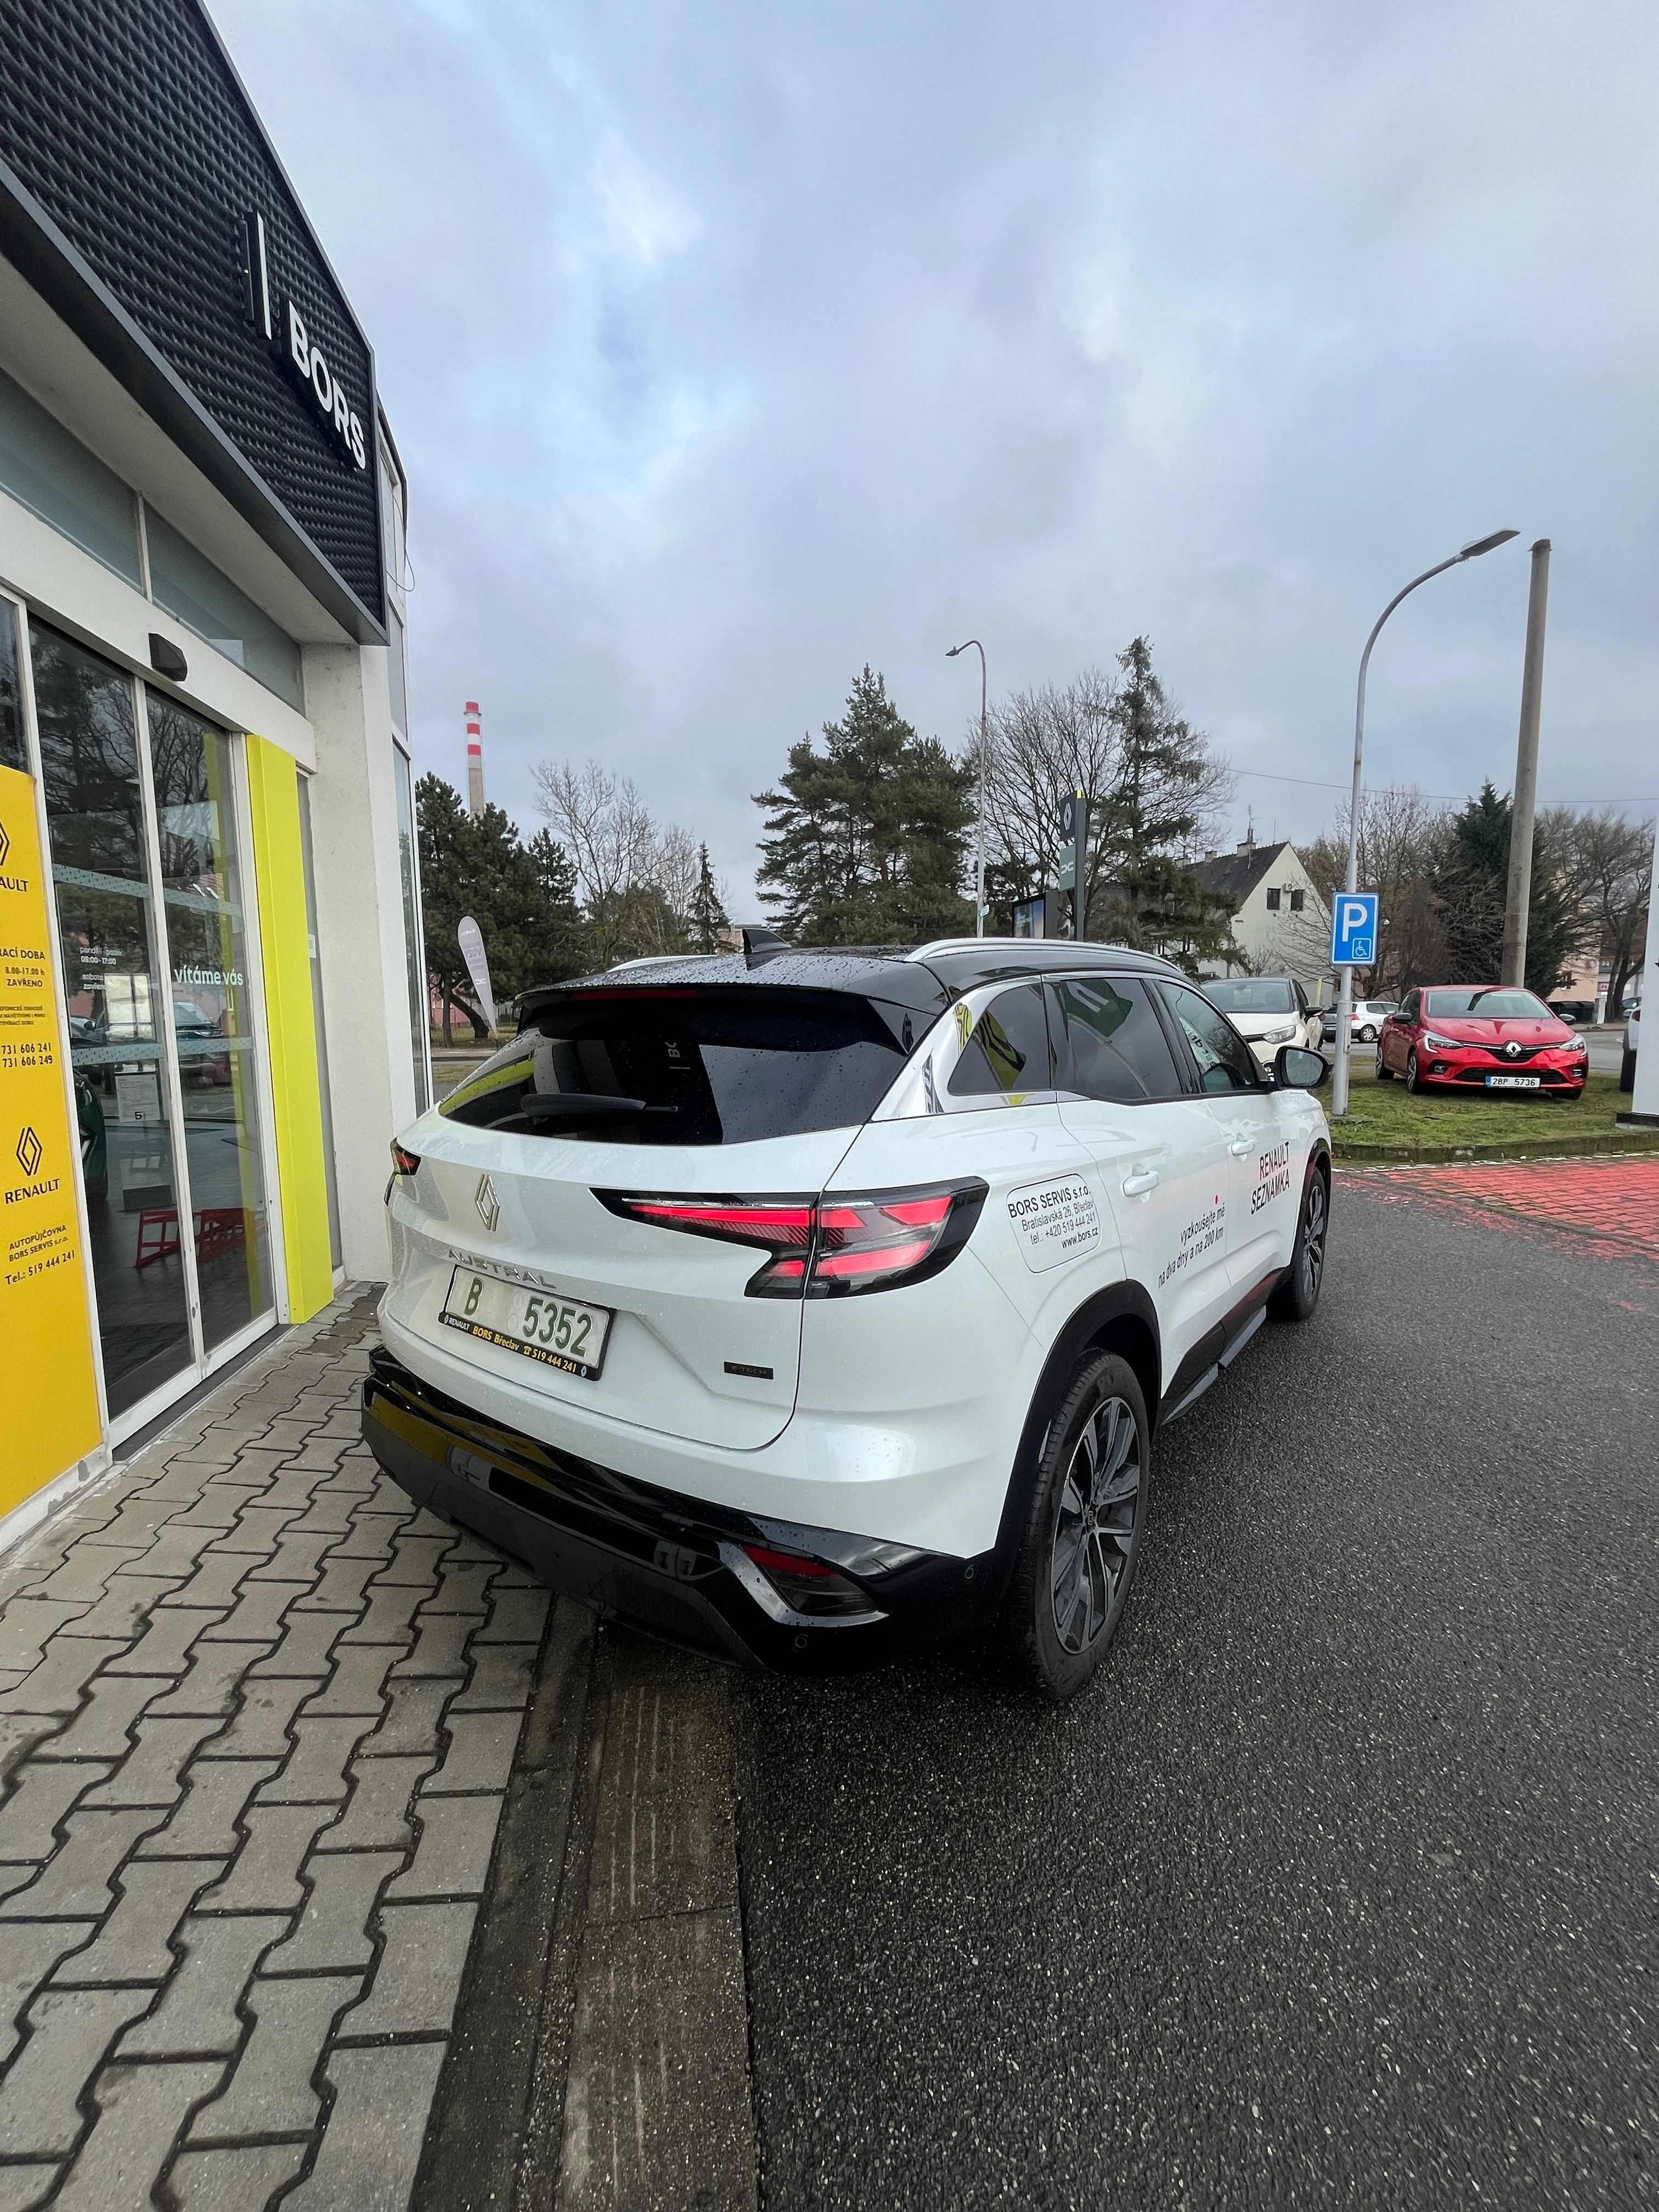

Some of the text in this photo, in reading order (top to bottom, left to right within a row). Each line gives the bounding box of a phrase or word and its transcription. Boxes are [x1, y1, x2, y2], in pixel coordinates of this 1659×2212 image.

[289, 300, 366, 470] BORS
[1342, 902, 1368, 942] P
[20, 949, 46, 960] DOBA
[7, 977, 43, 987] ZAVŘENO
[174, 964, 244, 986] vítáme vás
[1, 1042, 52, 1054] 731 606 241
[2, 1057, 18, 1068] 731
[21, 1056, 36, 1066] 606
[134, 1111, 143, 1120] 5
[1260, 1141, 1289, 1181] RENAULT
[5, 1178, 60, 1204] RENAULT
[1008, 1186, 1091, 1218] BORS SERVIS s.r.o.
[1251, 1168, 1290, 1215] SEZNAMKA
[1021, 1199, 1094, 1232] Bratislavská 26, Břeclav
[1045, 1223, 1062, 1238] +420
[1063, 1219, 1074, 1234] 519
[1075, 1215, 1086, 1228] 444
[1086, 1212, 1096, 1224] 241
[1180, 1202, 1225, 1246] vyzkoušejte mě
[9, 1249, 29, 1262] BORS
[30, 1239, 53, 1254] SERVIS
[1061, 1227, 1099, 1249] www.bors.cz
[28, 1262, 43, 1277] 519
[46, 1255, 60, 1269] 444
[62, 1249, 75, 1263] 241
[448, 1247, 557, 1289] AUSTRAL
[1158, 1227, 1224, 1289] na dva dny a na 200 km
[463, 1276, 593, 1358] B 5352
[449, 1317, 577, 1373] RENAULT BORS Břeclav 519 444 241
